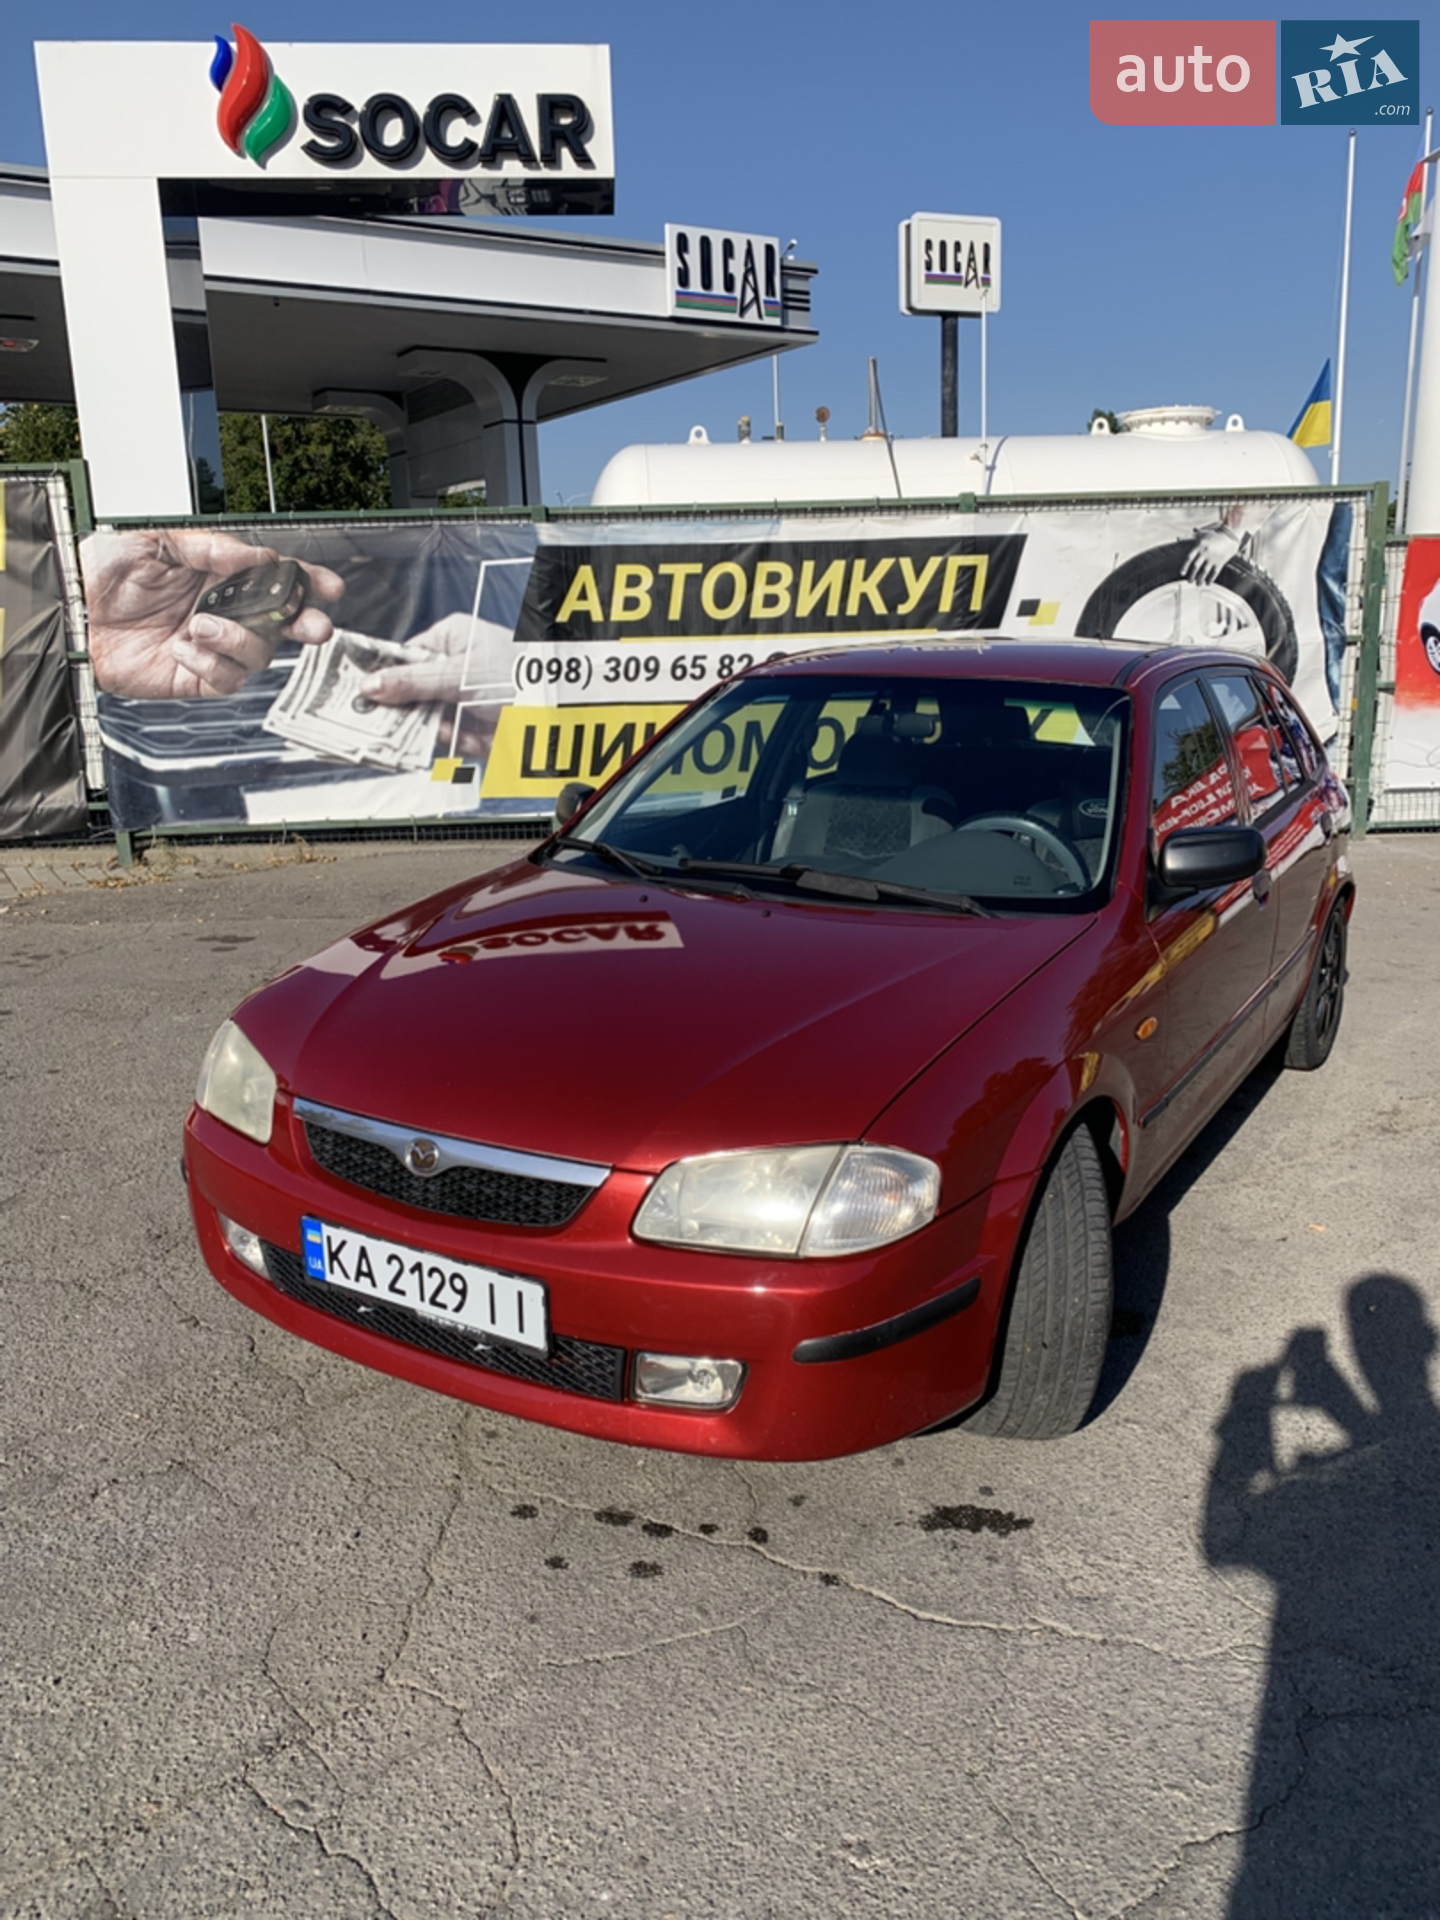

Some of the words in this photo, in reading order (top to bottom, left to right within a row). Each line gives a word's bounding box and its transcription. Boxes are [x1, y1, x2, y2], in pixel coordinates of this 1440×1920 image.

[300, 93, 595, 168] SOCAR
[676, 231, 777, 321] SOCAR
[923, 238, 991, 290] SOCAR
[554, 554, 989, 623] АВТОВИКУП
[515, 654, 594, 691] (098)
[603, 655, 661, 684] 309
[670, 654, 708, 682] 65
[308, 1255, 324, 1272] UA
[326, 1234, 378, 1289] KA
[386, 1252, 468, 1314] 2129
